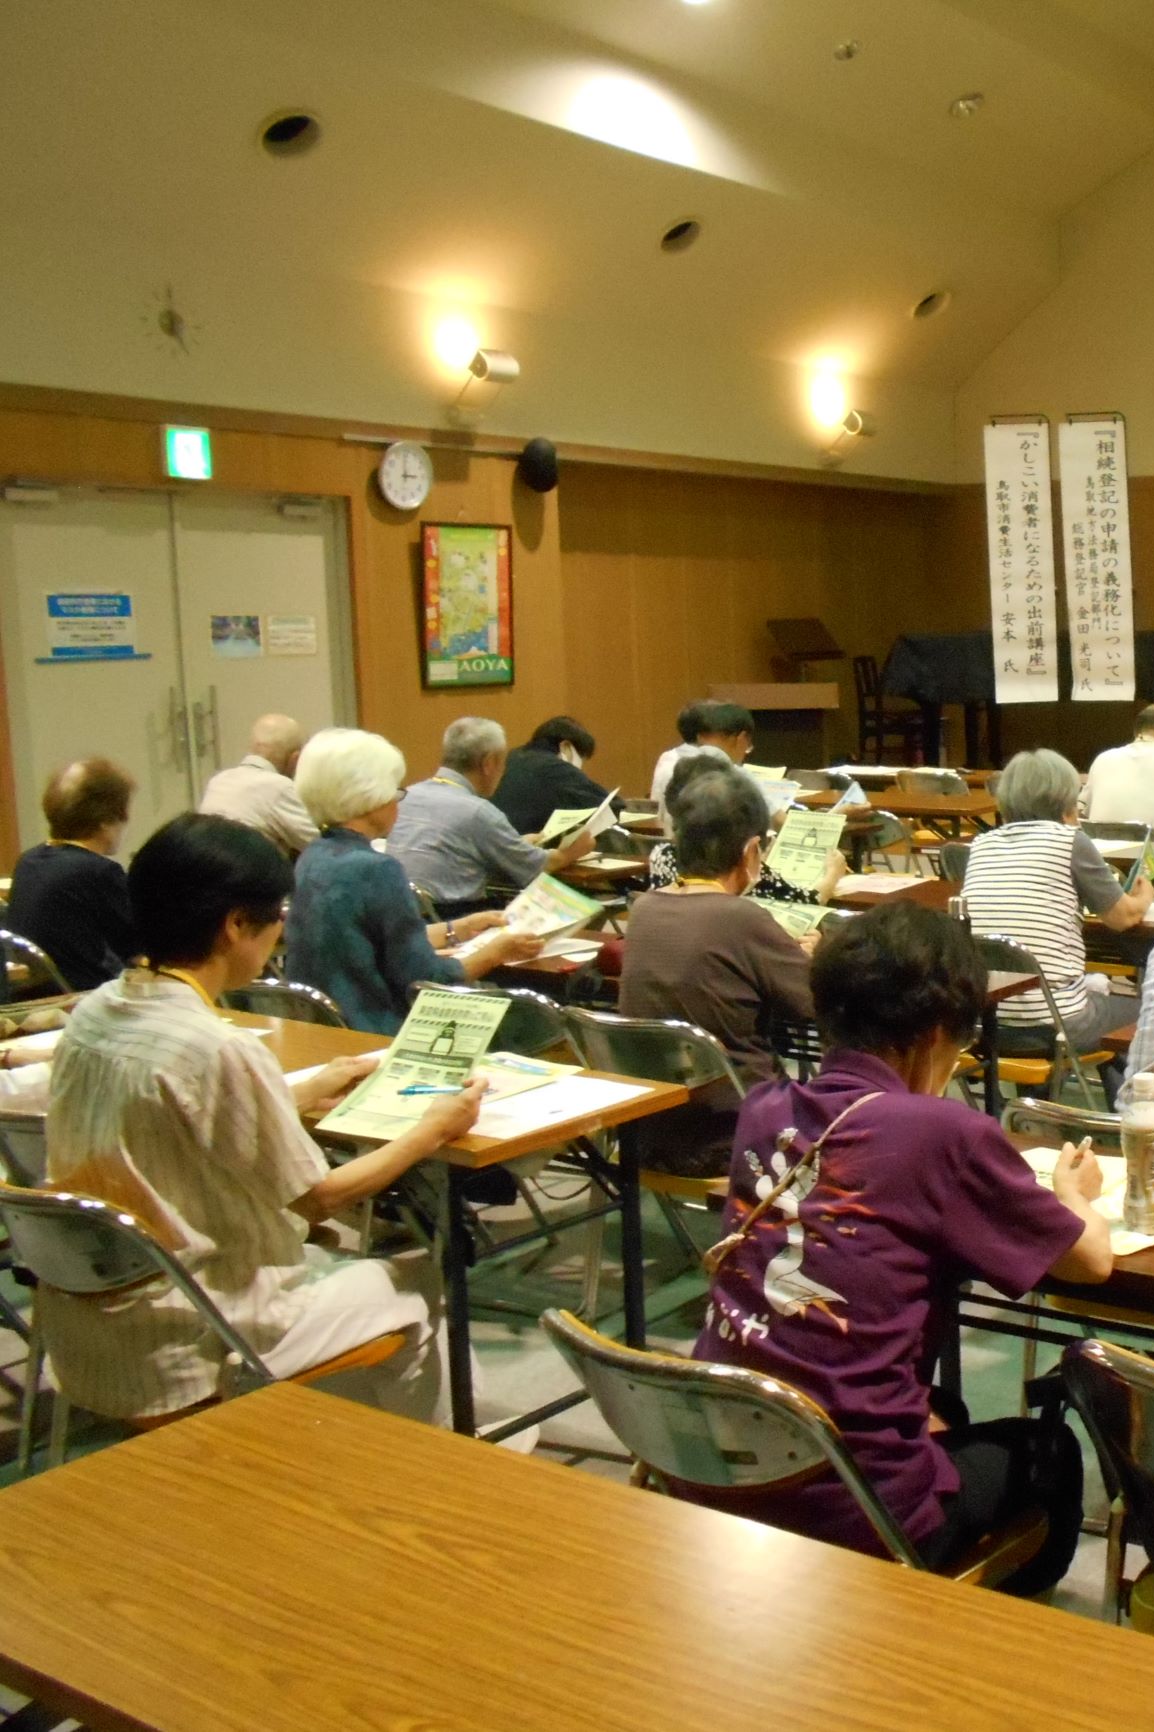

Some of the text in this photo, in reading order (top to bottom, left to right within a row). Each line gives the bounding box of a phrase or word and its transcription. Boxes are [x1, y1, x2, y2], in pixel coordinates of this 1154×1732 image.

[996, 480, 1019, 673] 鳥取市消費生活センター 安本 氏
[1017, 432, 1047, 676] 『かしこい消費者になるための出前講座』
[460, 658, 508, 671] AOYA
